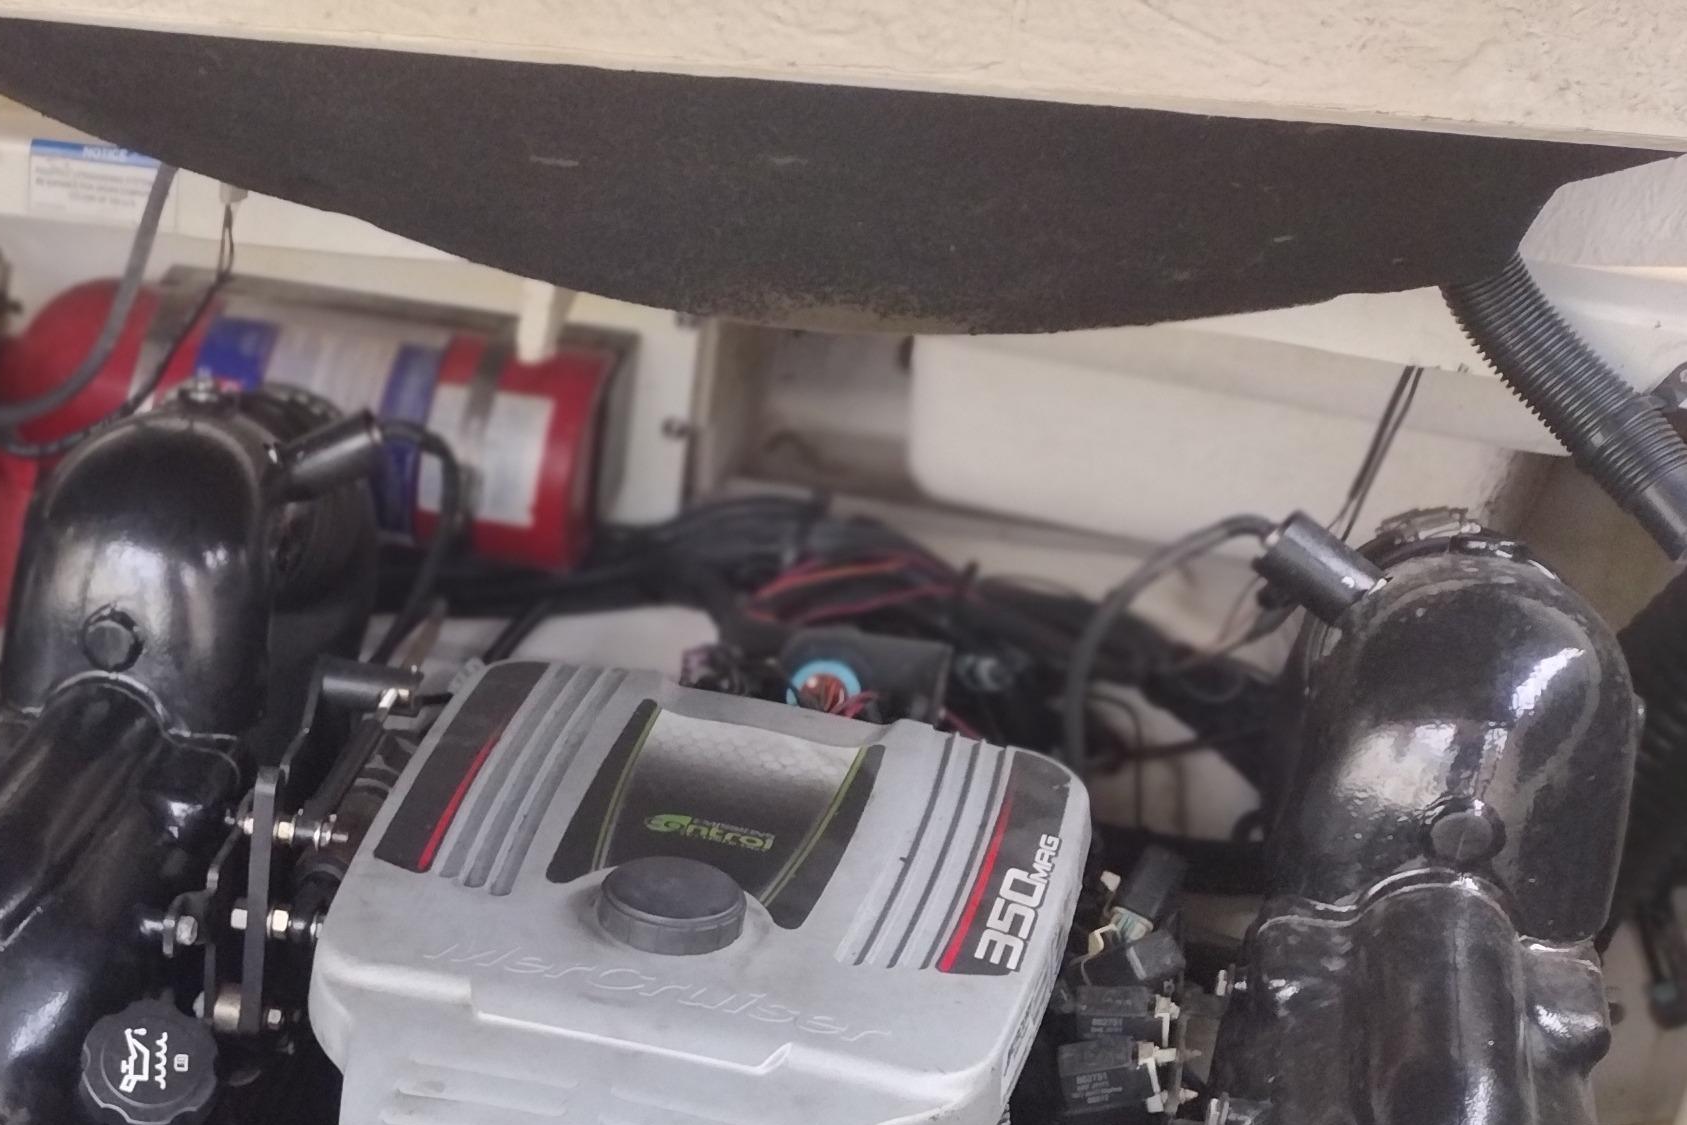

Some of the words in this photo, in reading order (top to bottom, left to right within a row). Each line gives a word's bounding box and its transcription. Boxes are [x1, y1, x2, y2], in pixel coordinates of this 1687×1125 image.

[973, 867, 1048, 970] 350
[1027, 834, 1061, 884] MAG
[423, 942, 892, 1042] MerCruiser
